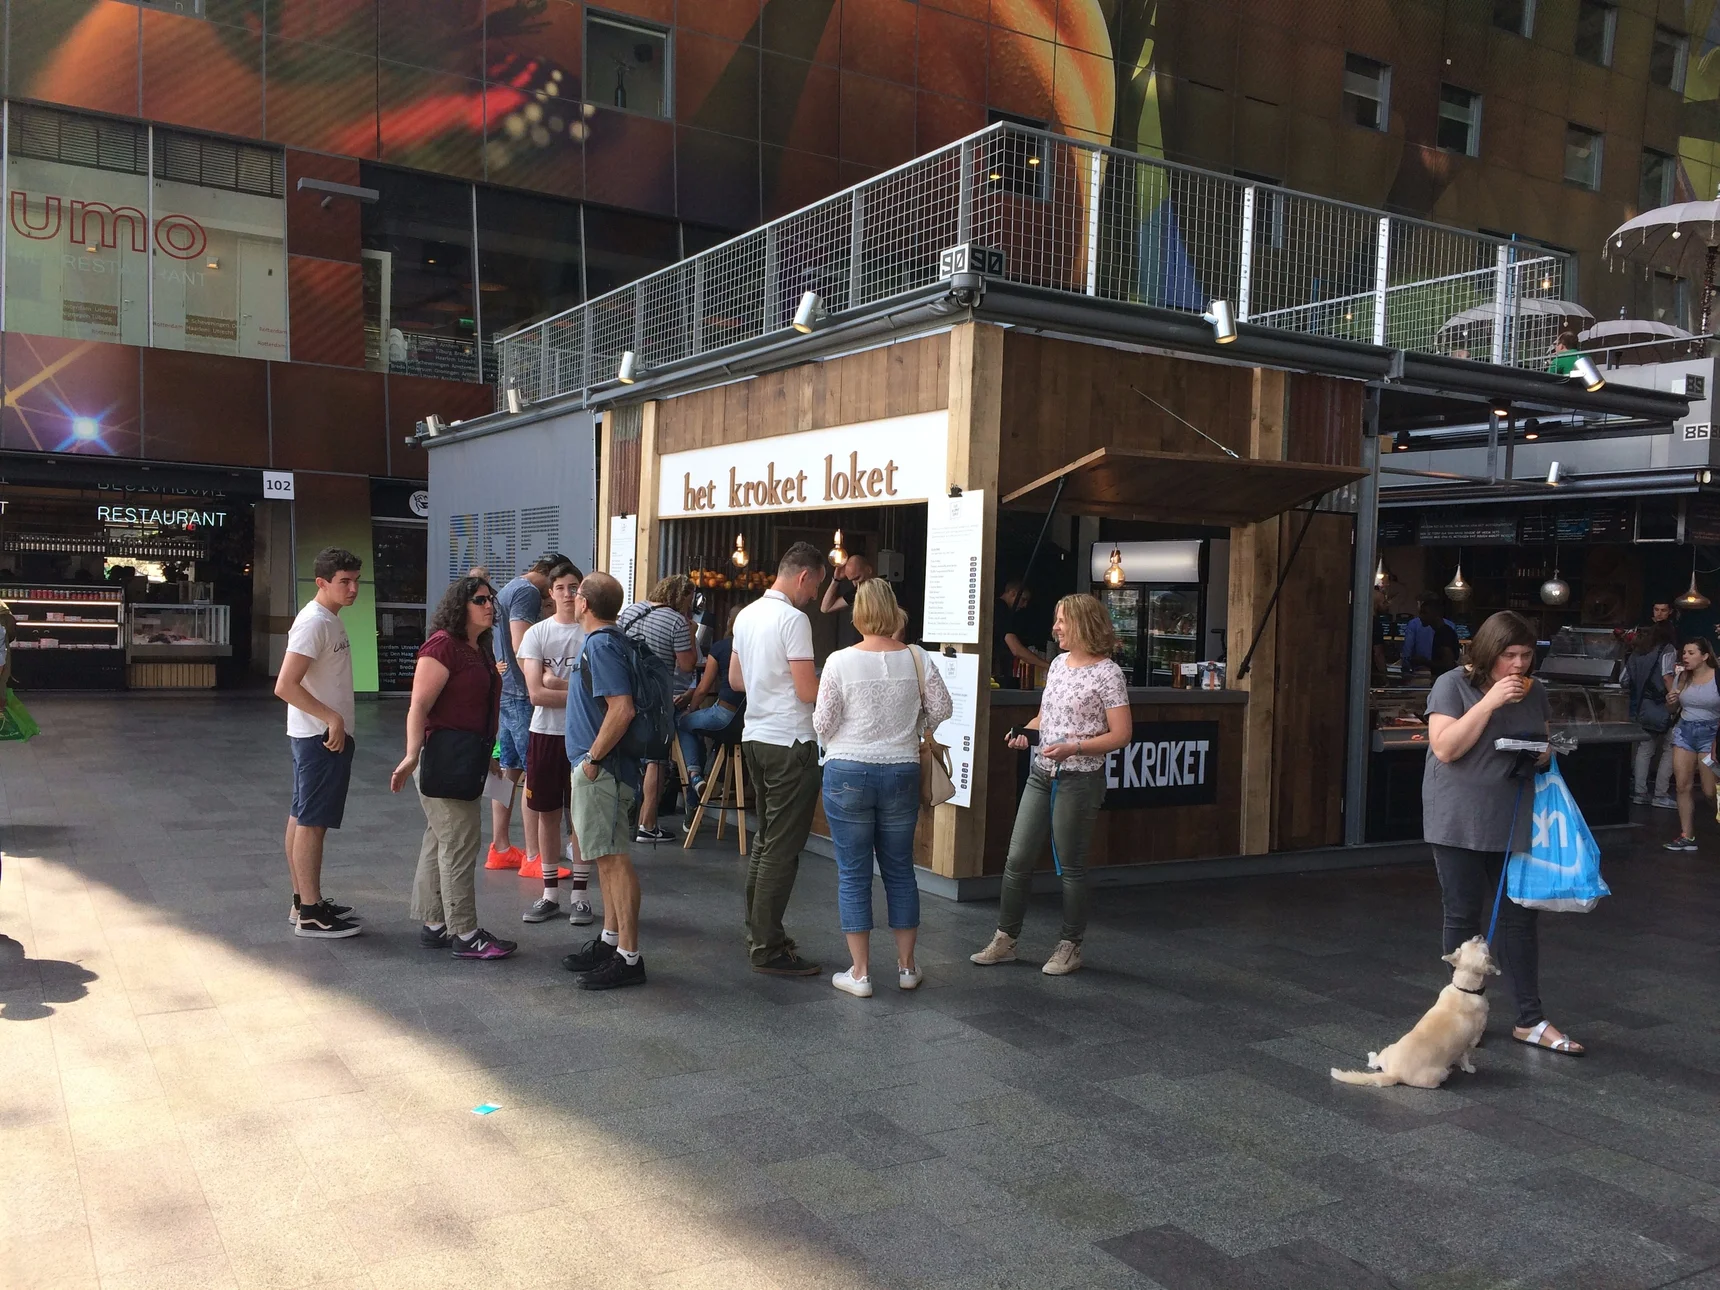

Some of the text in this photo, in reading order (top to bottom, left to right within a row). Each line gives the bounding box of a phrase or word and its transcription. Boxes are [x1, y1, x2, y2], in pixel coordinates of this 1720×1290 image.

[1685, 425, 1709, 439] 86
[266, 479, 292, 492] 102
[682, 450, 899, 512] het kroket loket
[97, 506, 227, 528] RESTAURANT
